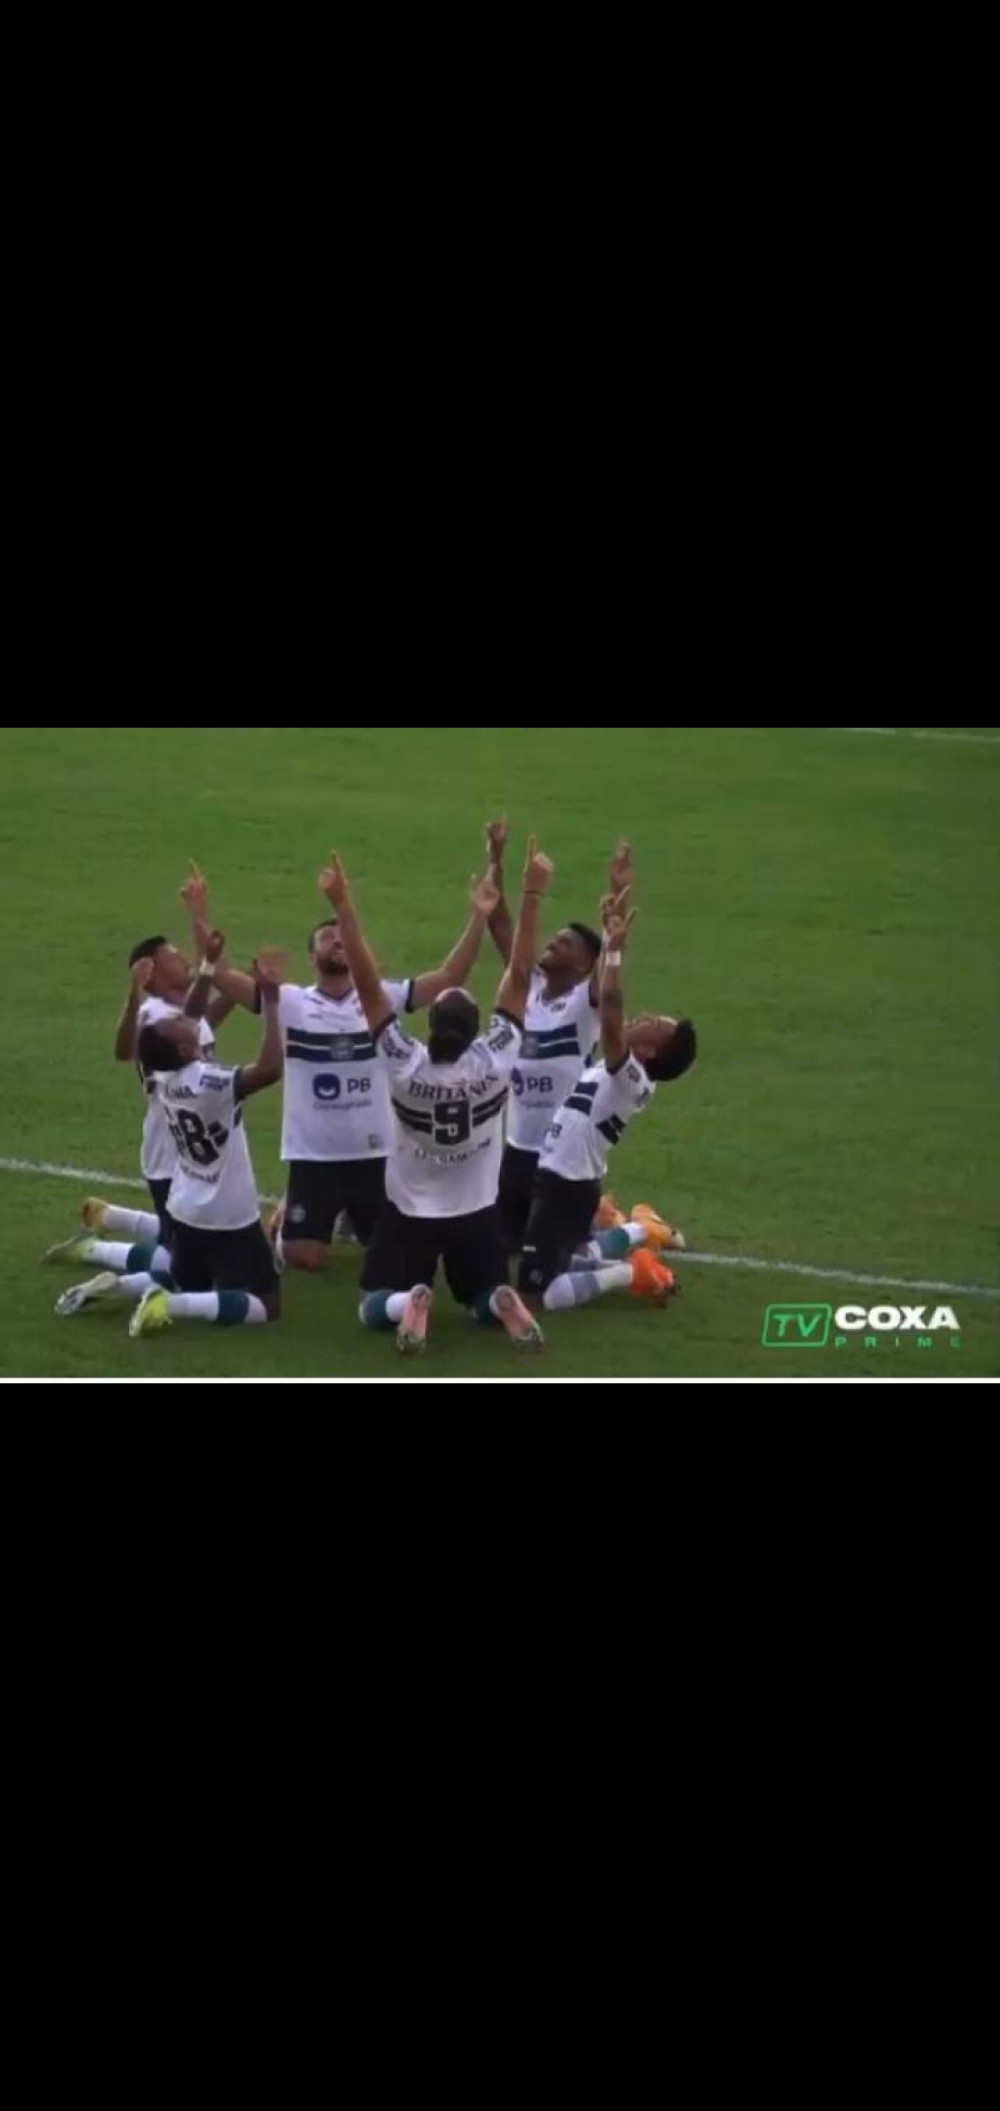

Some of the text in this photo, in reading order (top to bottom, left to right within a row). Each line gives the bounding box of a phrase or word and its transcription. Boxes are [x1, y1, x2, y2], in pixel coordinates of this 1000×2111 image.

[346, 1077, 371, 1094] PB
[526, 1077, 553, 1092] PB
[434, 1099, 470, 1146] 9
